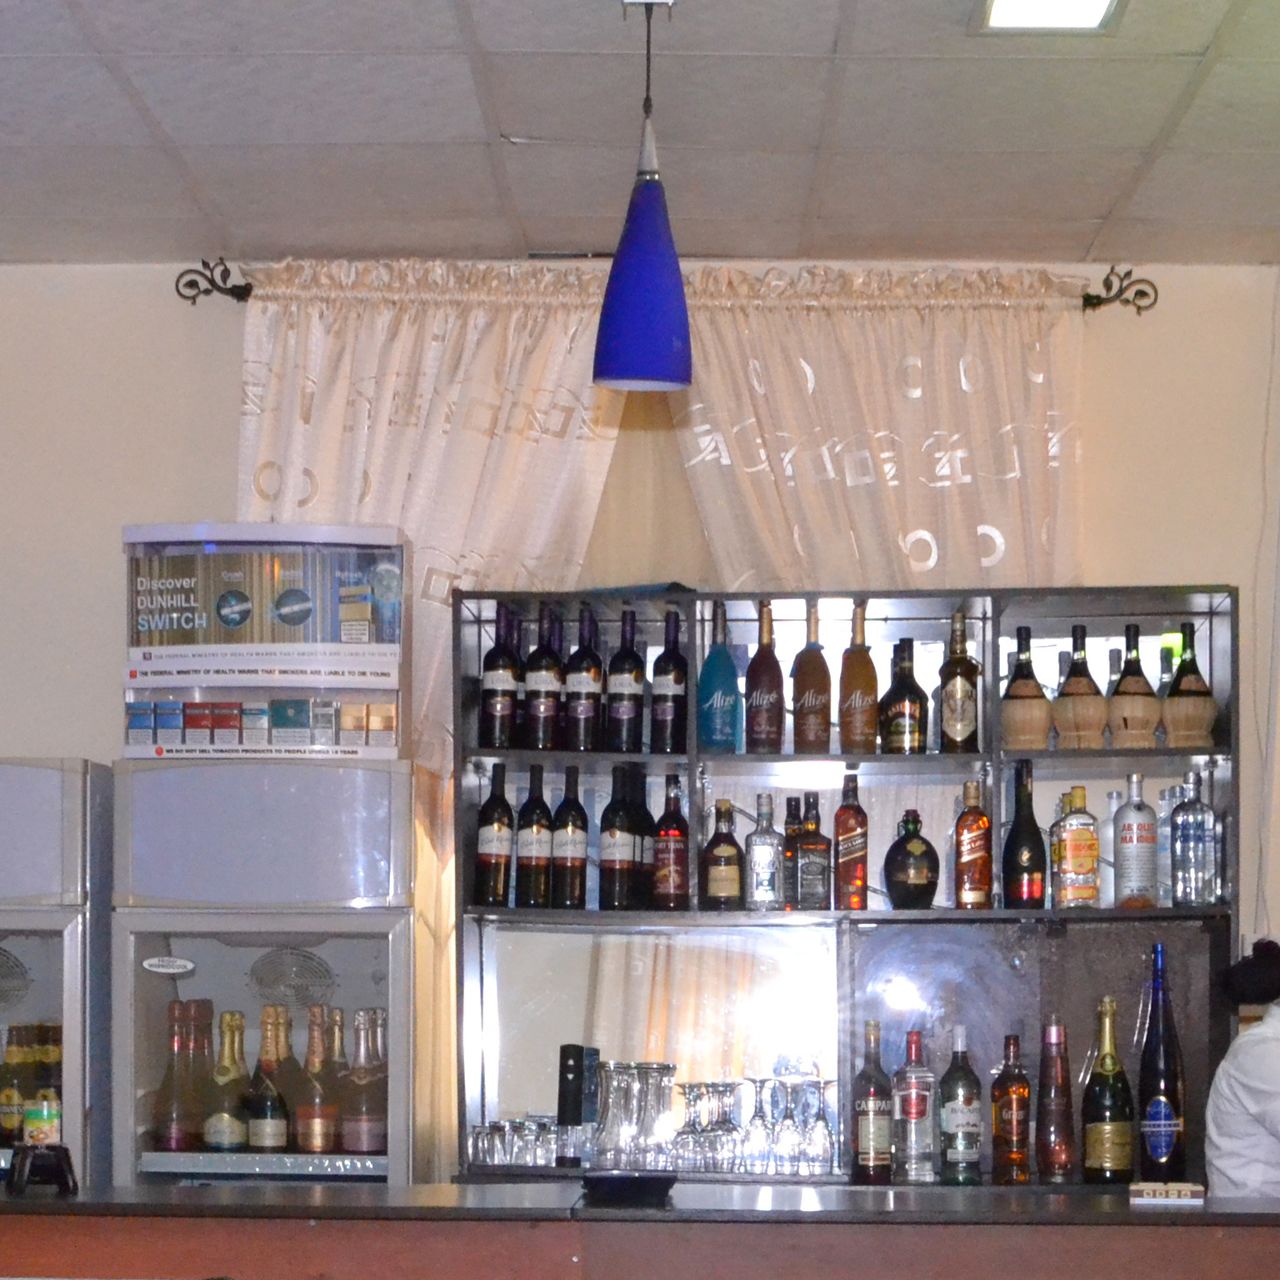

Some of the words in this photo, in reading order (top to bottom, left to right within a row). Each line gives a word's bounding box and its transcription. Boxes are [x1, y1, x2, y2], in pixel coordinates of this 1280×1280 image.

[137, 576, 198, 591] Discover
[137, 594, 200, 610] DUNHILL
[137, 612, 208, 632] SWITCH
[369, 670, 391, 678] YOUNG
